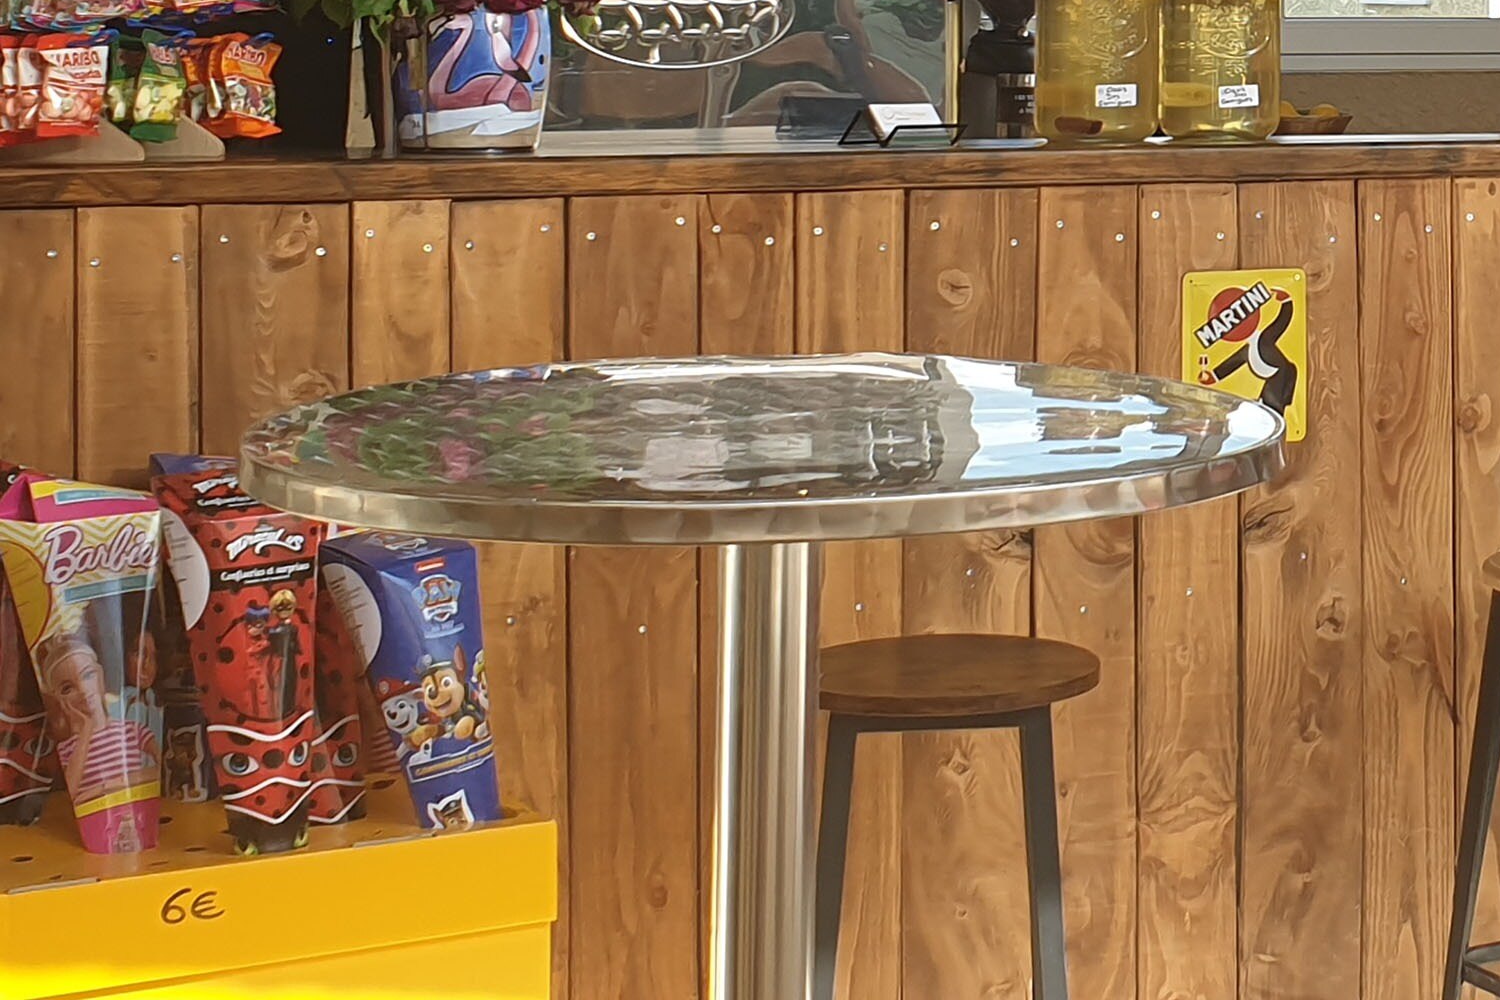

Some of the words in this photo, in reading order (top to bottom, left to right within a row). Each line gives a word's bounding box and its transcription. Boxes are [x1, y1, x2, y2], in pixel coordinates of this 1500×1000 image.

[1197, 283, 1270, 347] MARTINI
[44, 523, 159, 585] Barbie
[161, 887, 225, 925] 6€
